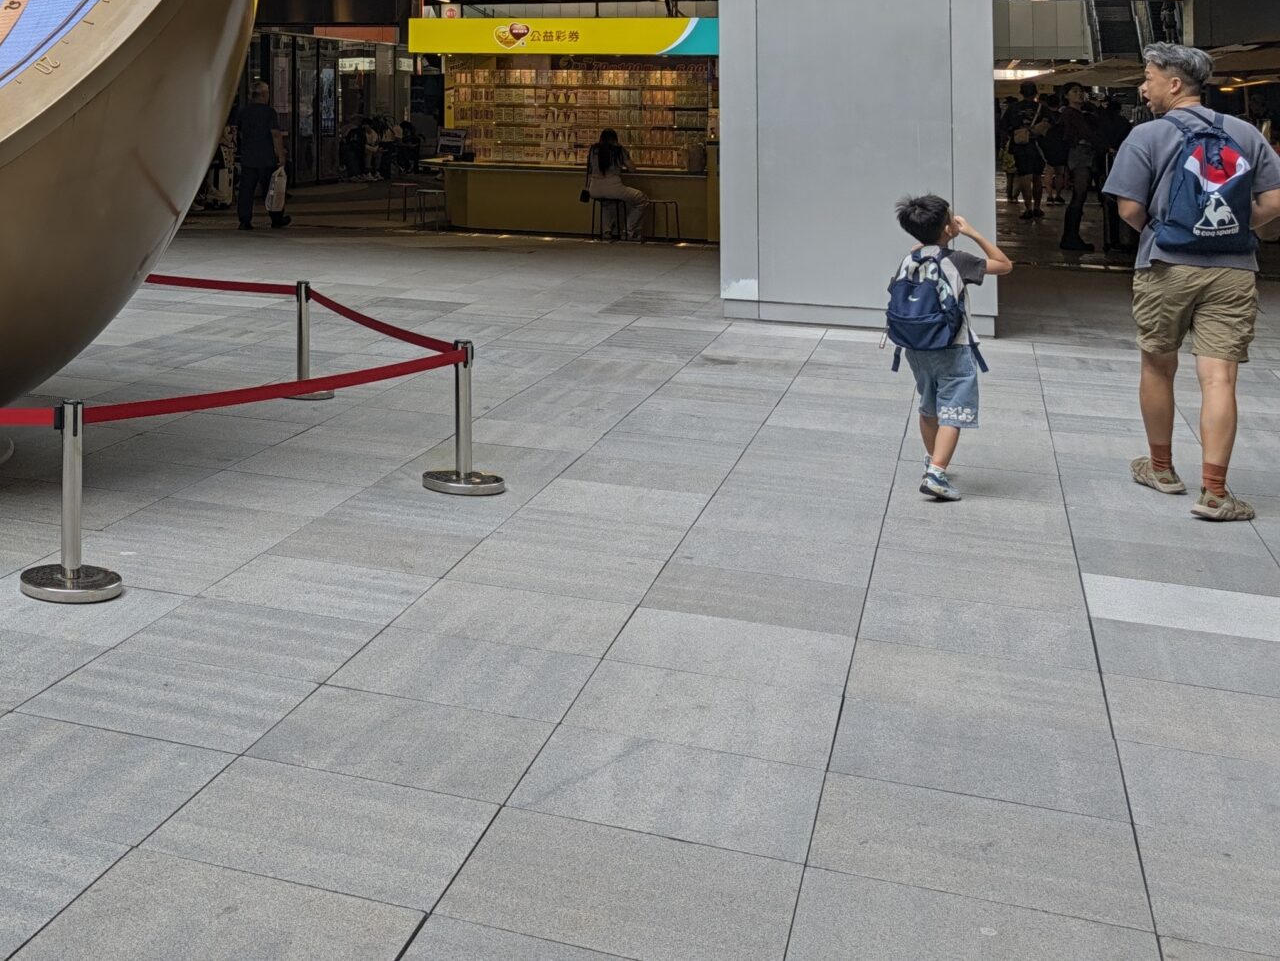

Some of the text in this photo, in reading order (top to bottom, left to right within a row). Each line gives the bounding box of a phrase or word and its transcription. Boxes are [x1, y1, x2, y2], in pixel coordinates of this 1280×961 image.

[530, 29, 580, 43] 公益彩券
[34, 55, 61, 75] 20
[1192, 227, 1200, 236] le
